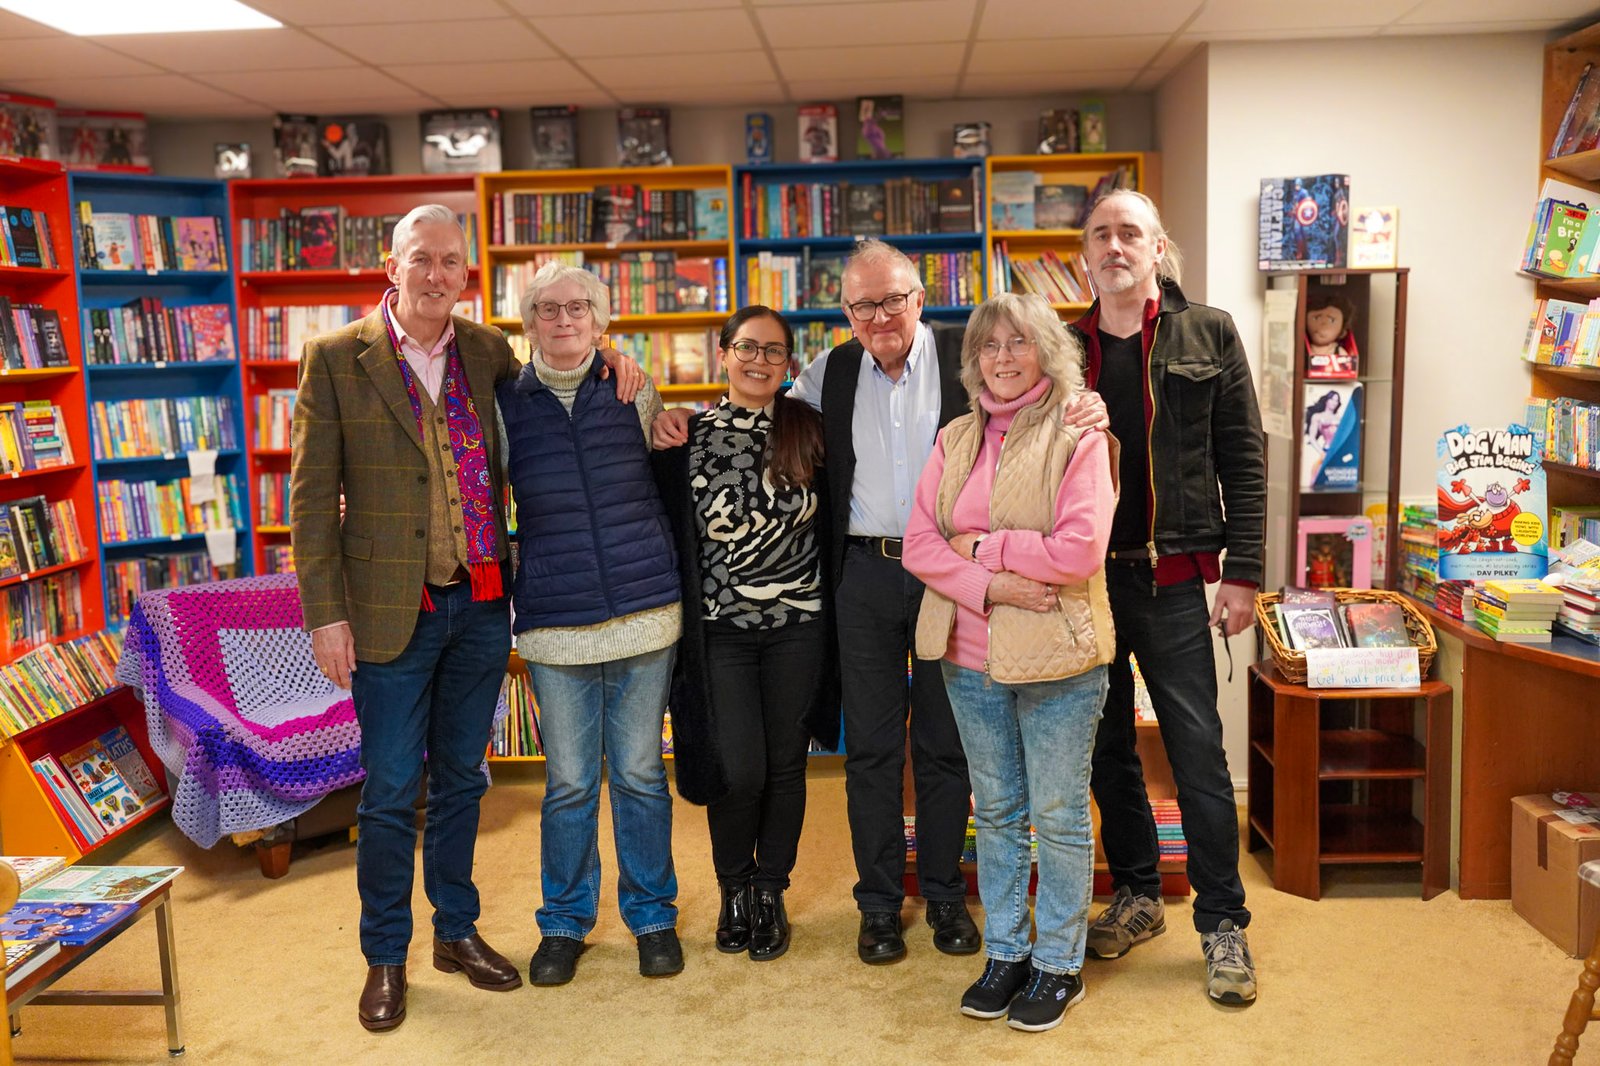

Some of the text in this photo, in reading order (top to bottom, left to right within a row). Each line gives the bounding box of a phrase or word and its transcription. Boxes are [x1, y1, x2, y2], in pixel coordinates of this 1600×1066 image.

[1271, 188, 1284, 260] CAPTAIN
[1445, 431, 1532, 458] DOG MAN
